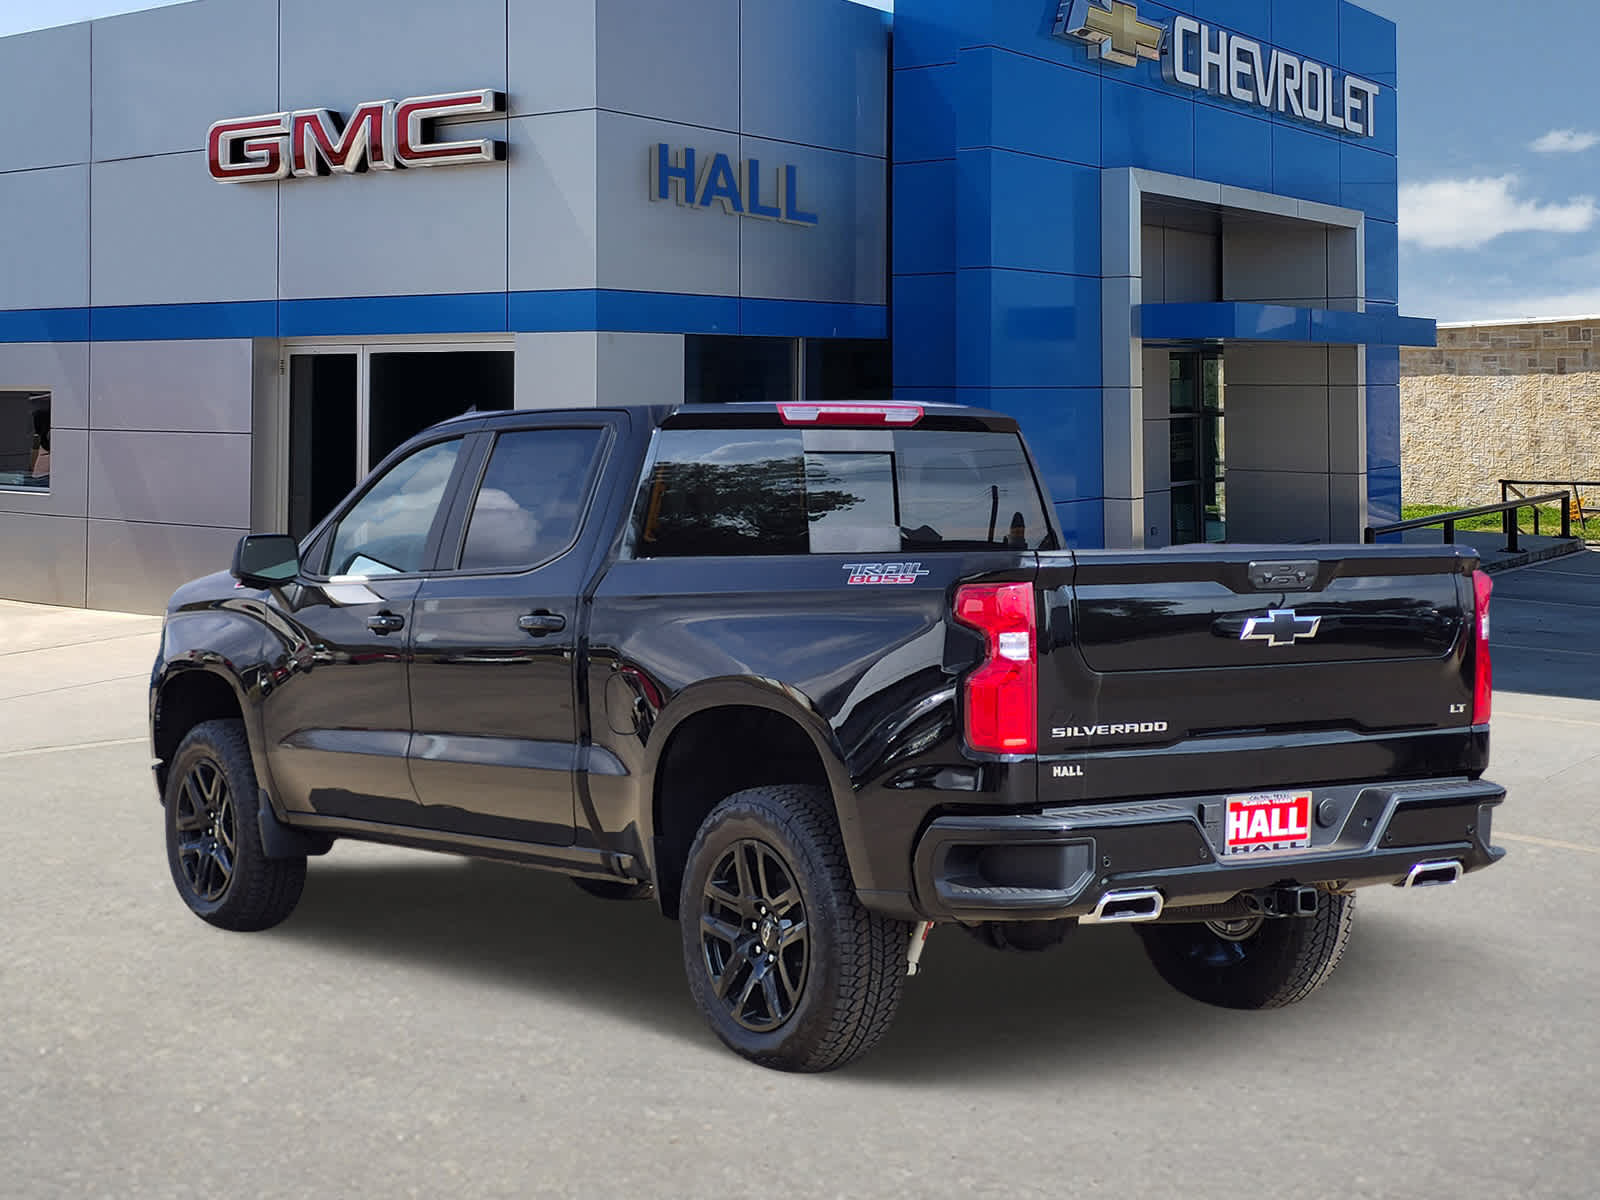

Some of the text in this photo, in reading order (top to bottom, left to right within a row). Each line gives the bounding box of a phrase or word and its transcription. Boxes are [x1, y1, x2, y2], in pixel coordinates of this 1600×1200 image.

[1172, 15, 1380, 137] CHEVROLET
[207, 89, 507, 184] GMC
[651, 142, 819, 226] HALL
[842, 562, 930, 576] TRAIL
[847, 574, 917, 585] BOSS
[1450, 703, 1467, 713] LT
[1051, 721, 1169, 738] SILVERADO
[1052, 765, 1083, 777] HALL
[1229, 806, 1307, 840] HALL
